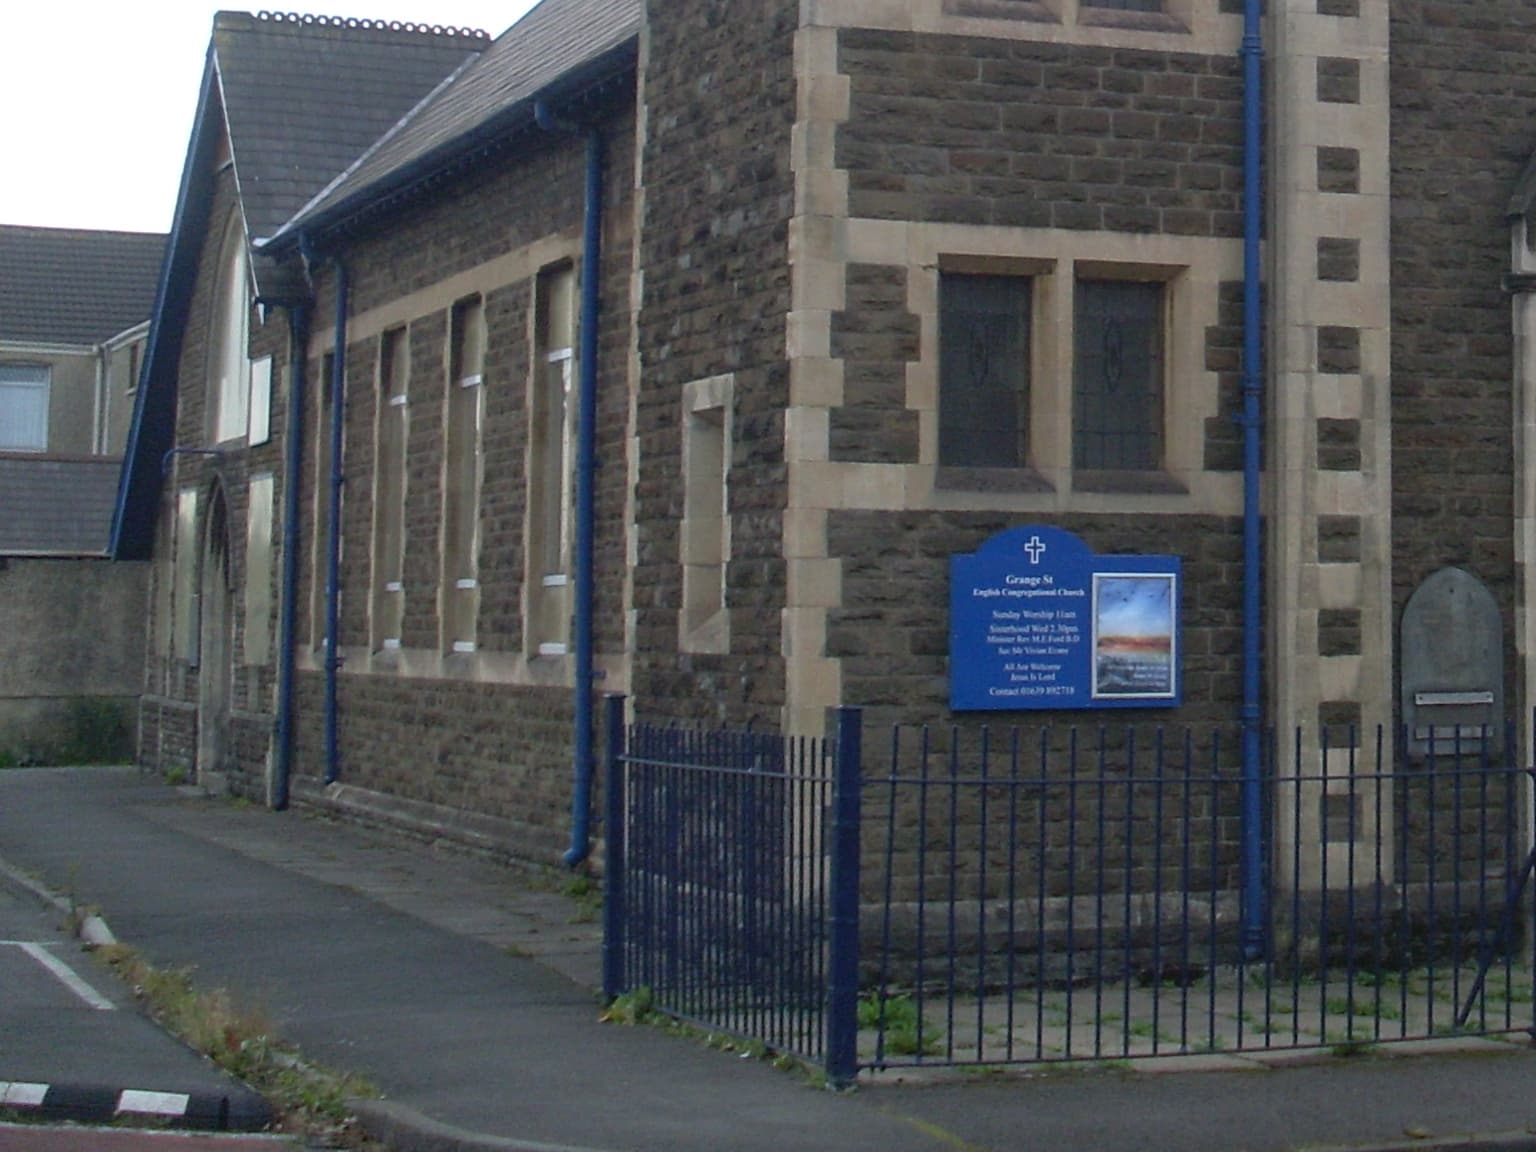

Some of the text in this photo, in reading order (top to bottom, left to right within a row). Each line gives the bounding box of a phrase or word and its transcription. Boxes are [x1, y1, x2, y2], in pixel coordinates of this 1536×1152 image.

[1006, 574, 1053, 587] Grange St
[973, 588, 1085, 598] English Congregational Church
[993, 610, 1076, 620] Sunday Worship 11am
[1031, 624, 1049, 632] Wed
[1010, 672, 1029, 681] Jesus
[989, 687, 1019, 696] Contact
